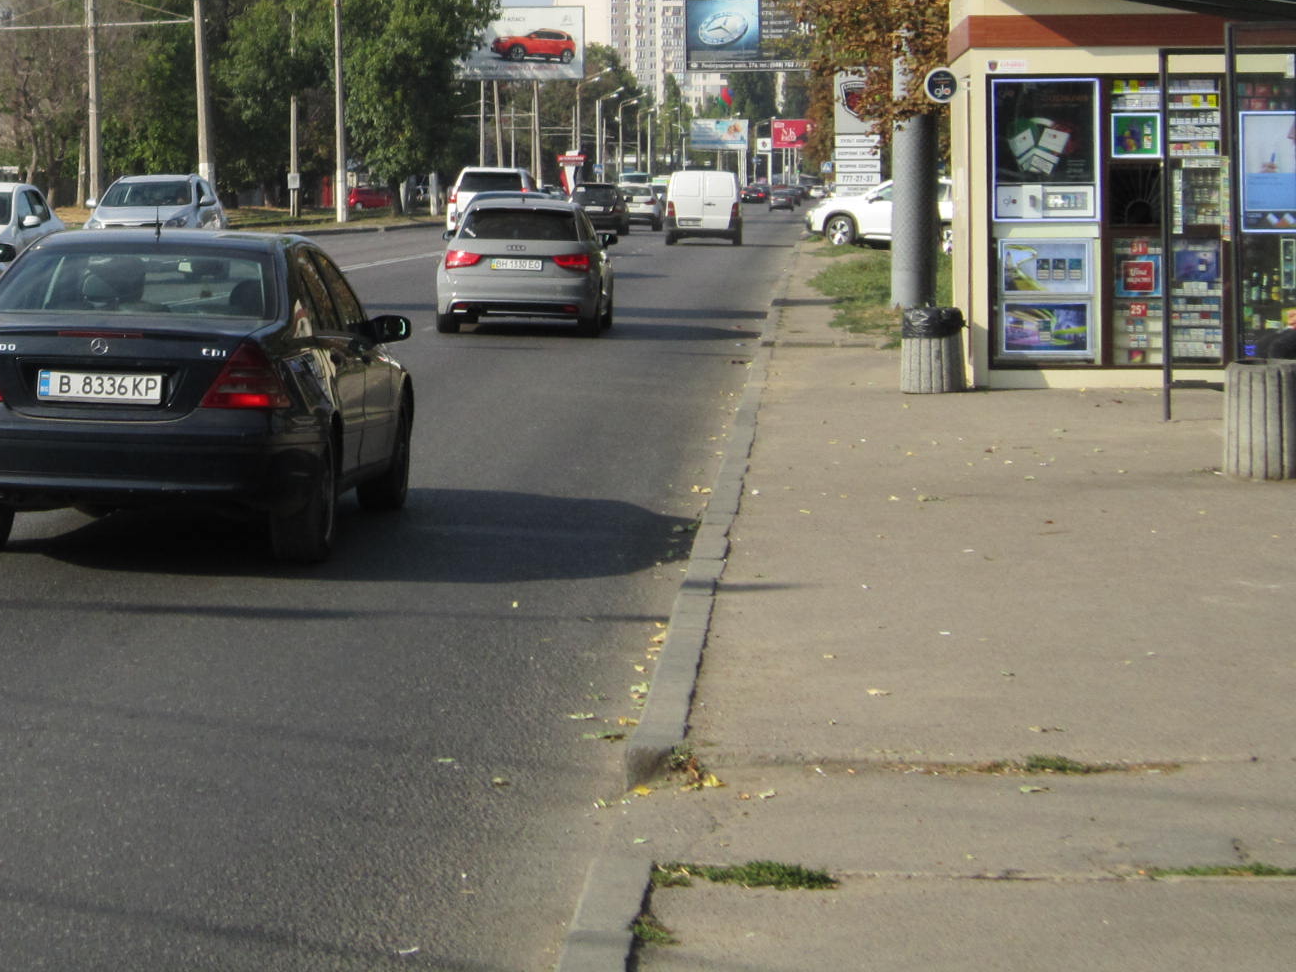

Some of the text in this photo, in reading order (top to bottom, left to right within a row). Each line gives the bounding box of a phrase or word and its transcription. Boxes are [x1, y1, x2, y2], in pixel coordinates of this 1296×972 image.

[201, 348, 226, 357] CDI
[59, 375, 158, 396] B 8336 KP
